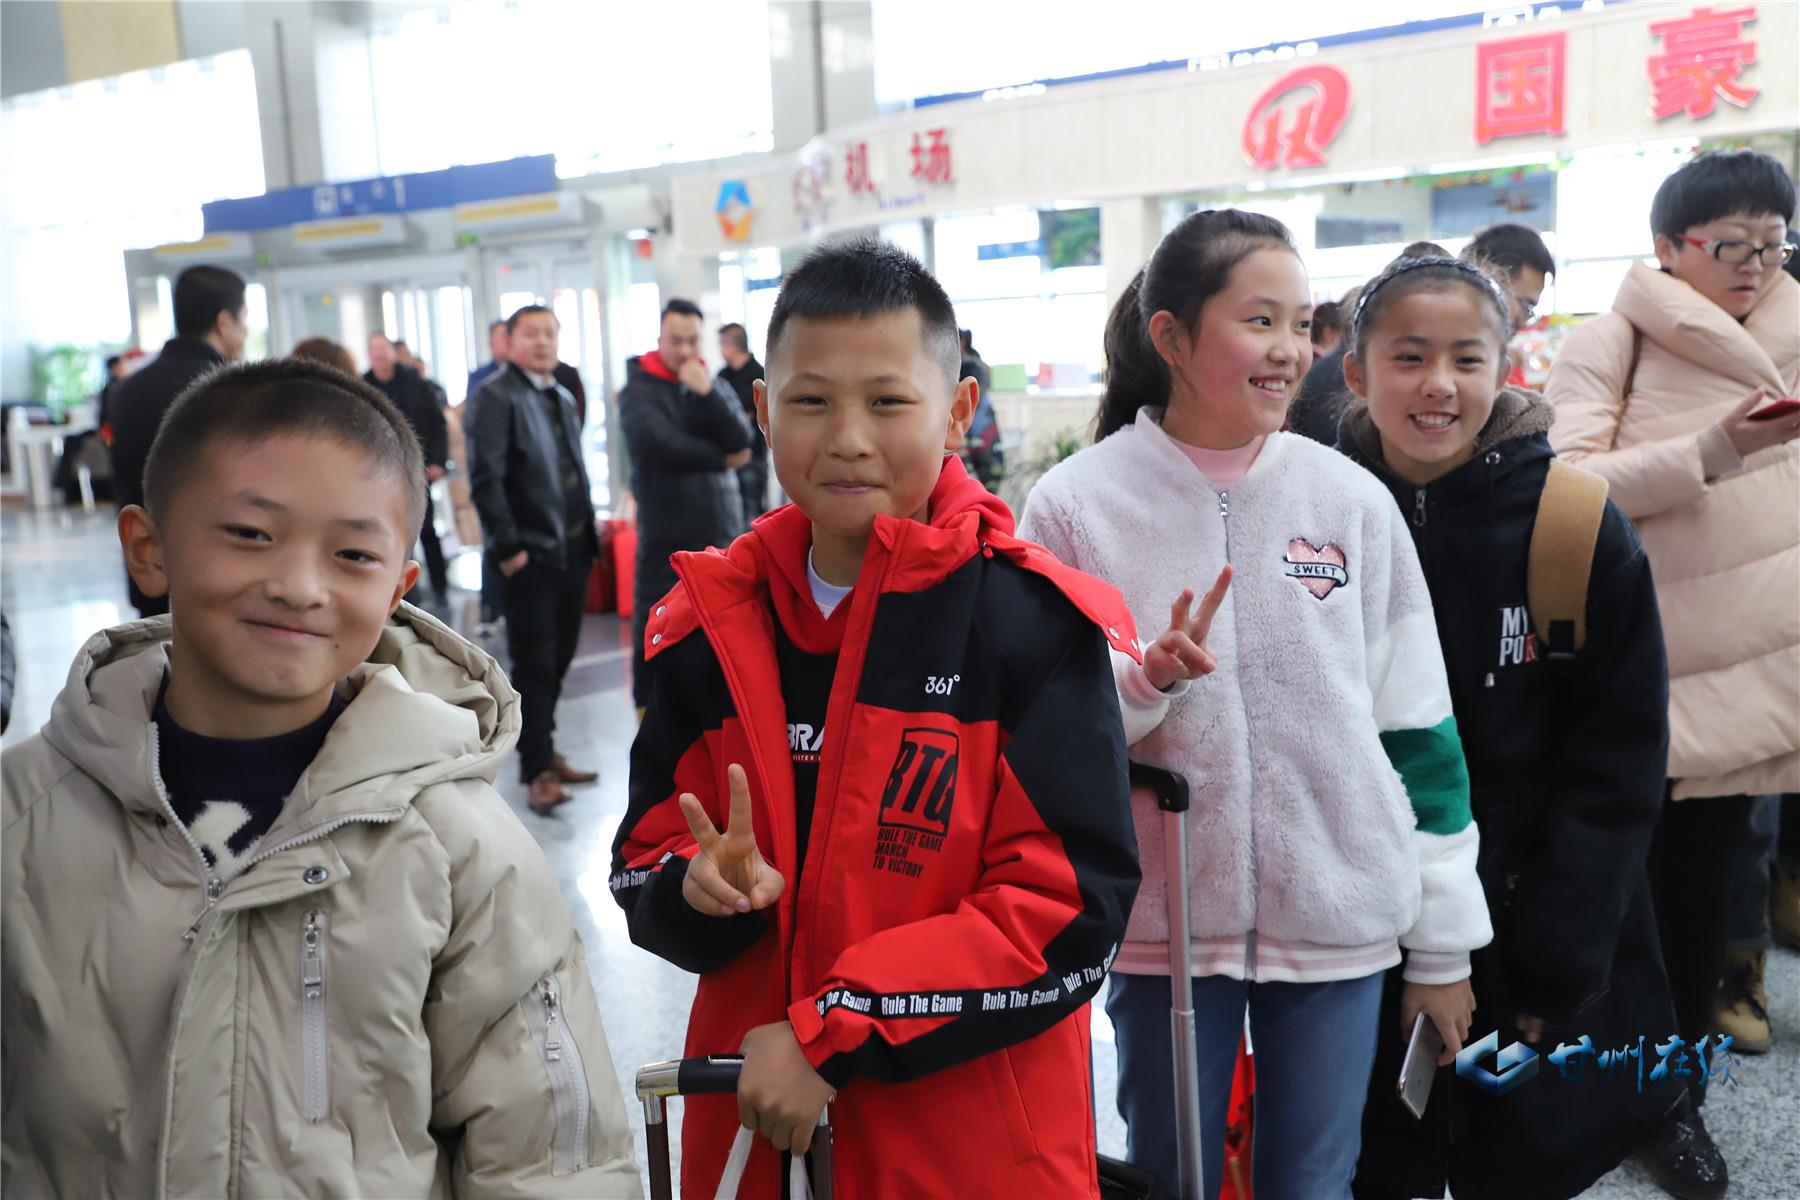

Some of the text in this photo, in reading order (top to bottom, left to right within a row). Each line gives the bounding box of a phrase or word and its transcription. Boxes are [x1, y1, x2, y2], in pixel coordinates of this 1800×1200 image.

[1474, 6, 1760, 145] 国豪
[1294, 564, 1338, 577] SWEET
[875, 842, 910, 860] MARCH
[877, 827, 900, 842] RULE
[918, 833, 944, 853] GAME
[873, 855, 925, 878] TO VICTORY
[1082, 966, 1102, 983] The
[841, 990, 872, 1012] Game
[881, 994, 963, 1015] Rule The Game
[982, 987, 1060, 1011] Rule The Game
